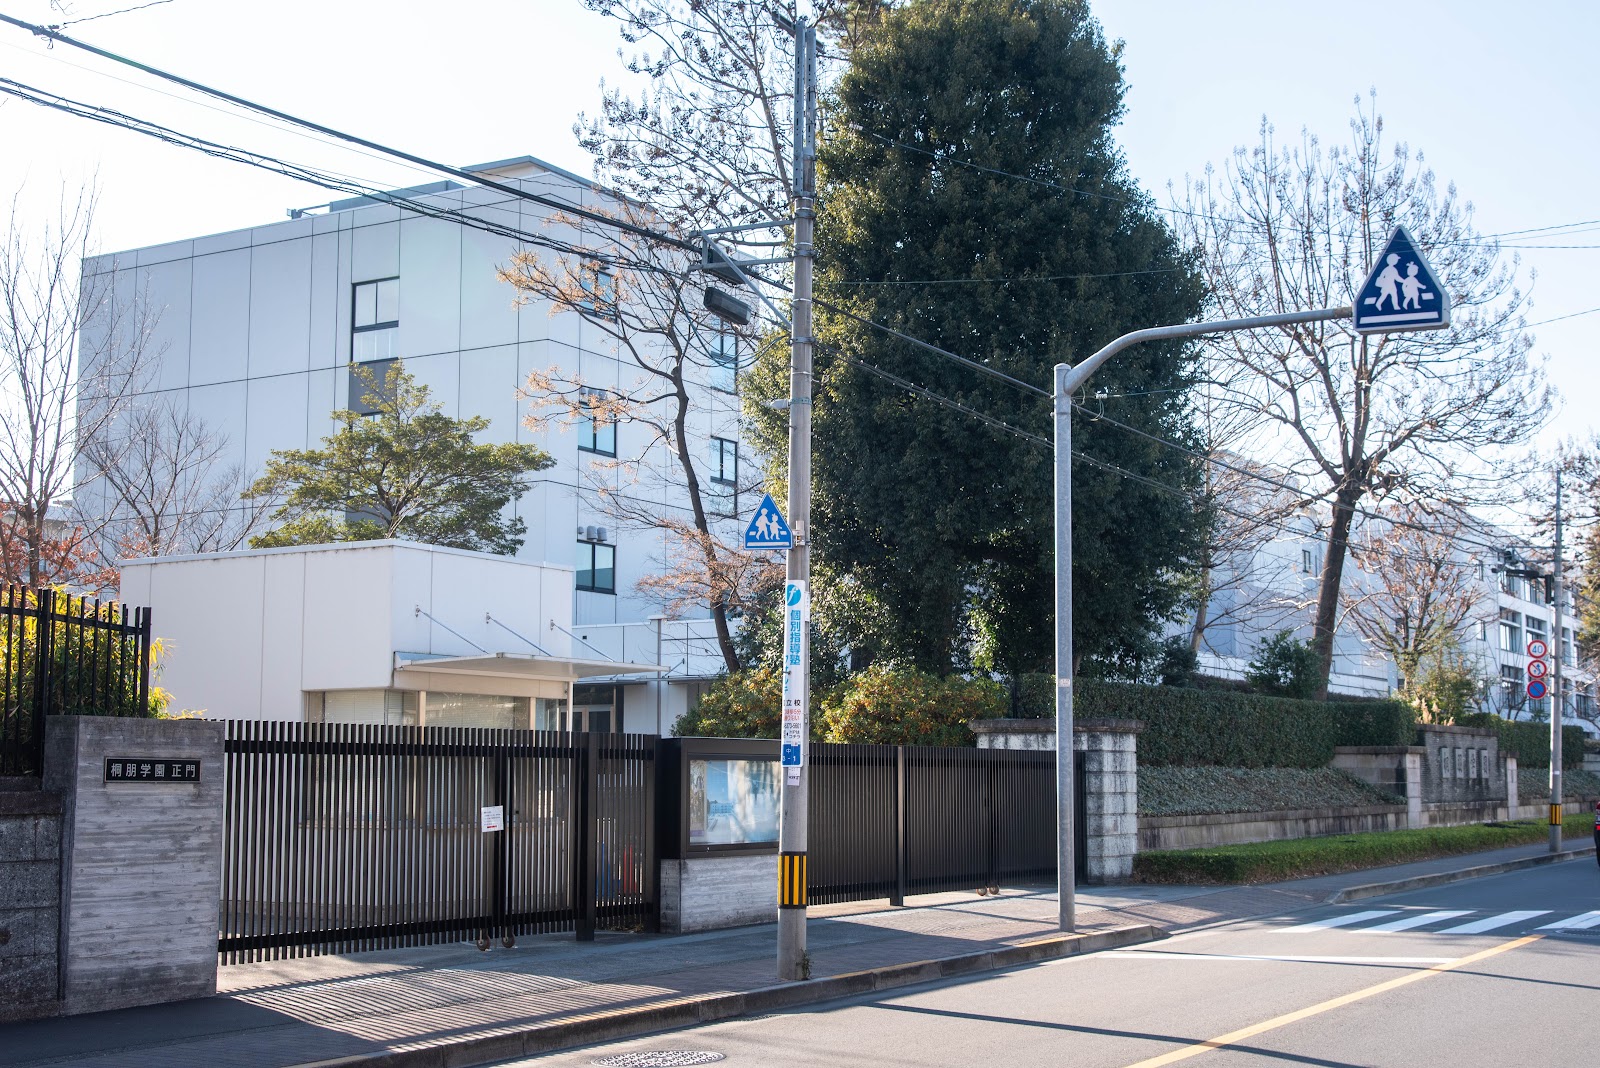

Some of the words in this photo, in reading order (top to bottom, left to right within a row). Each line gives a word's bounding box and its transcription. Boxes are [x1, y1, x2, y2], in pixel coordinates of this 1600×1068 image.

[790, 610, 801, 665] 個別指導塾
[1532, 645, 1543, 653] 40
[111, 763, 165, 778] 桐朋学園
[172, 764, 196, 778] 正門
